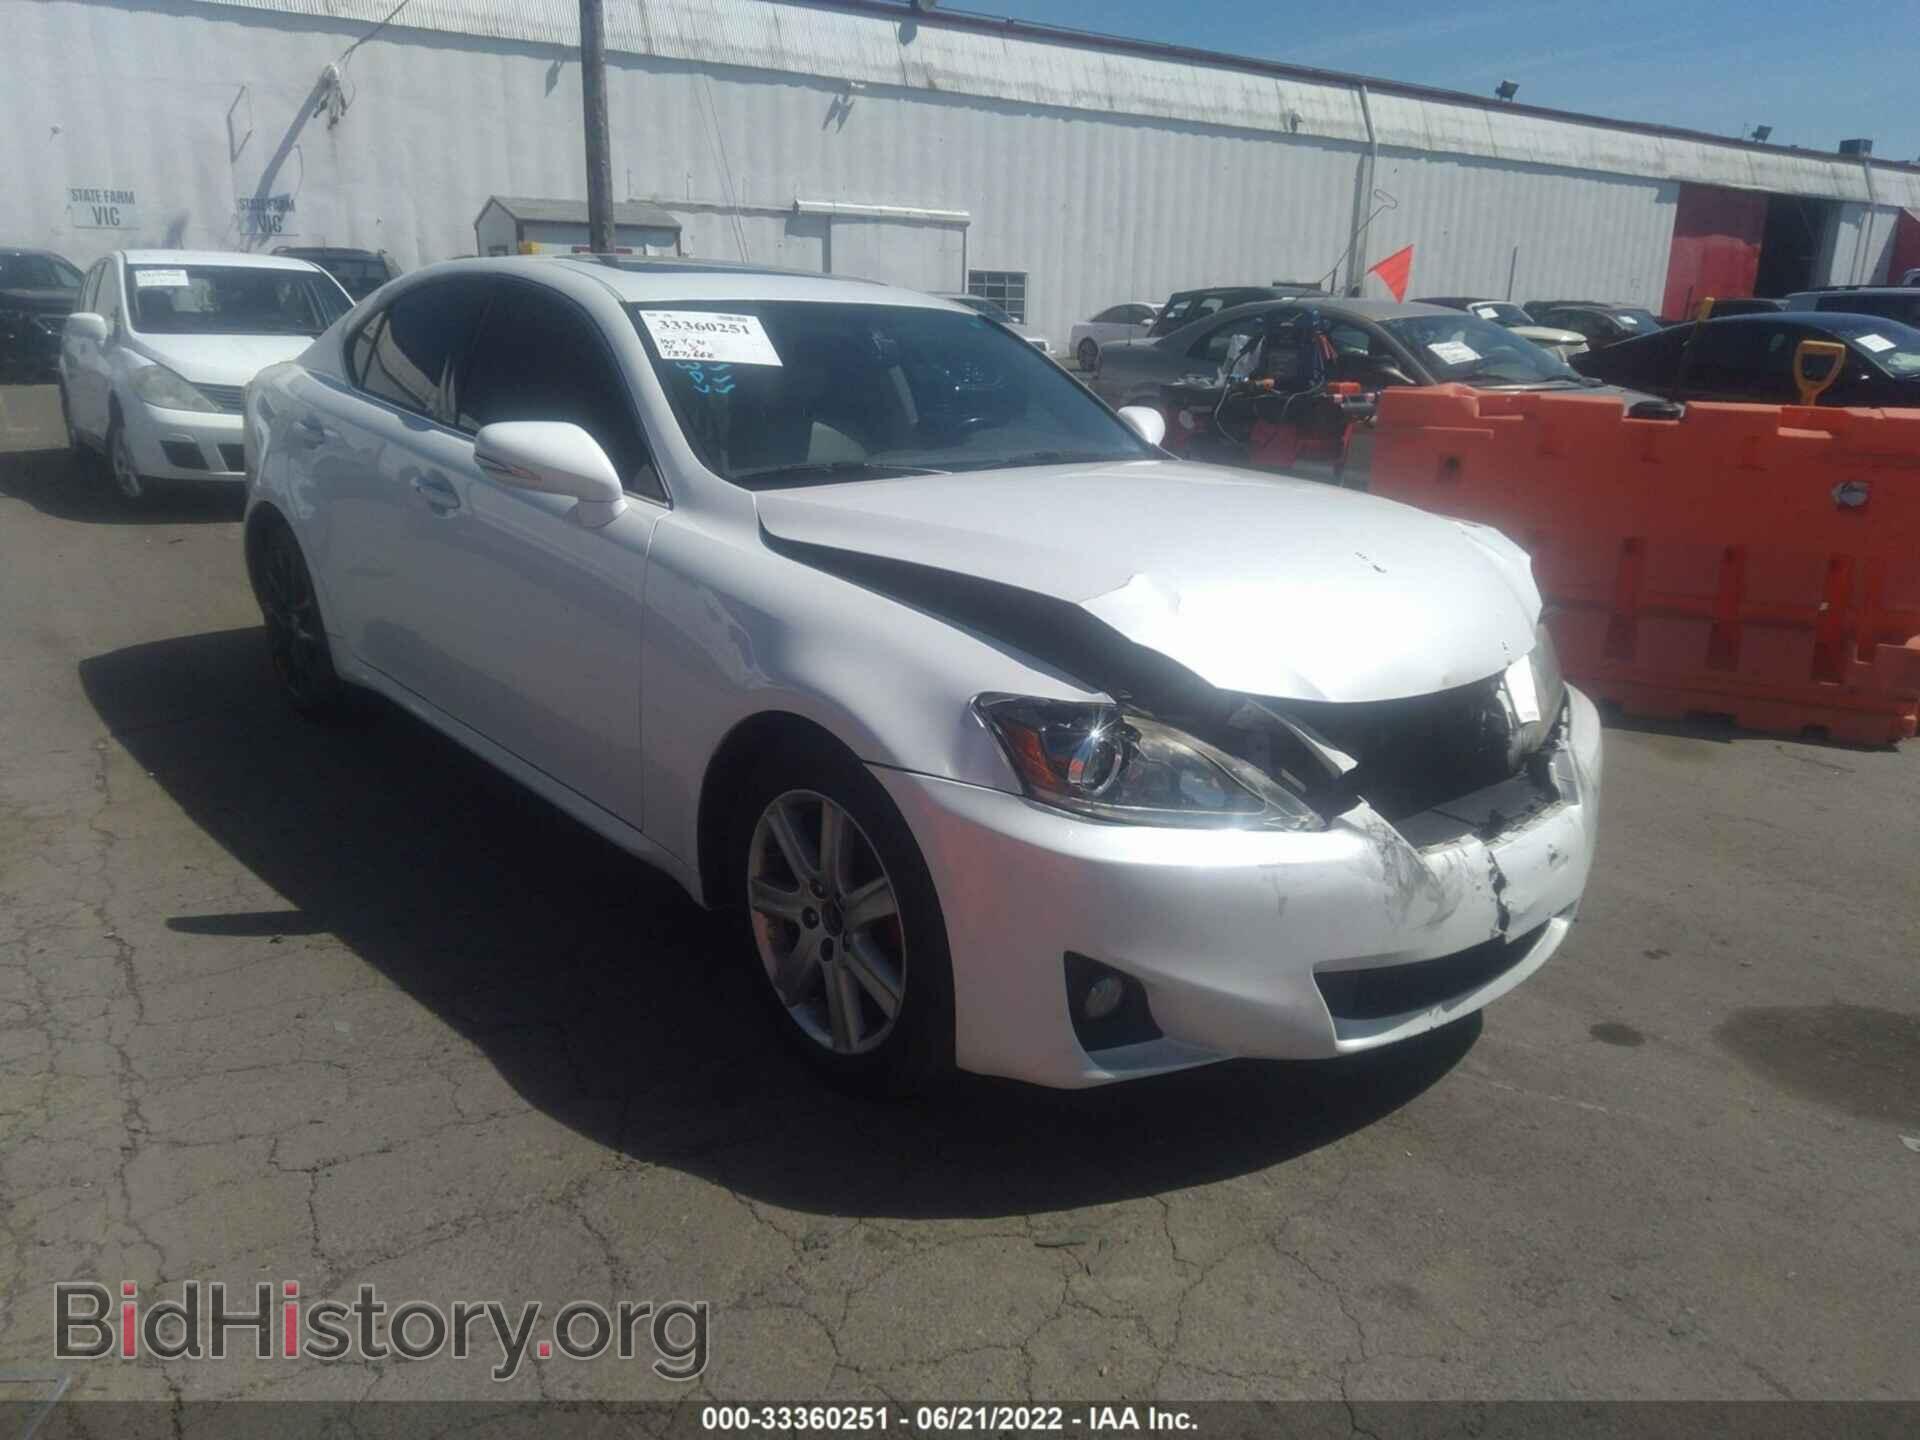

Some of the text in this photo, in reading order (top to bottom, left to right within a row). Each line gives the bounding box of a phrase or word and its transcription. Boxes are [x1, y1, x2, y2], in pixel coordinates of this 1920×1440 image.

[71, 188, 136, 205] STATE FARM
[92, 205, 121, 227] VIC
[659, 320, 751, 335] 33360251
